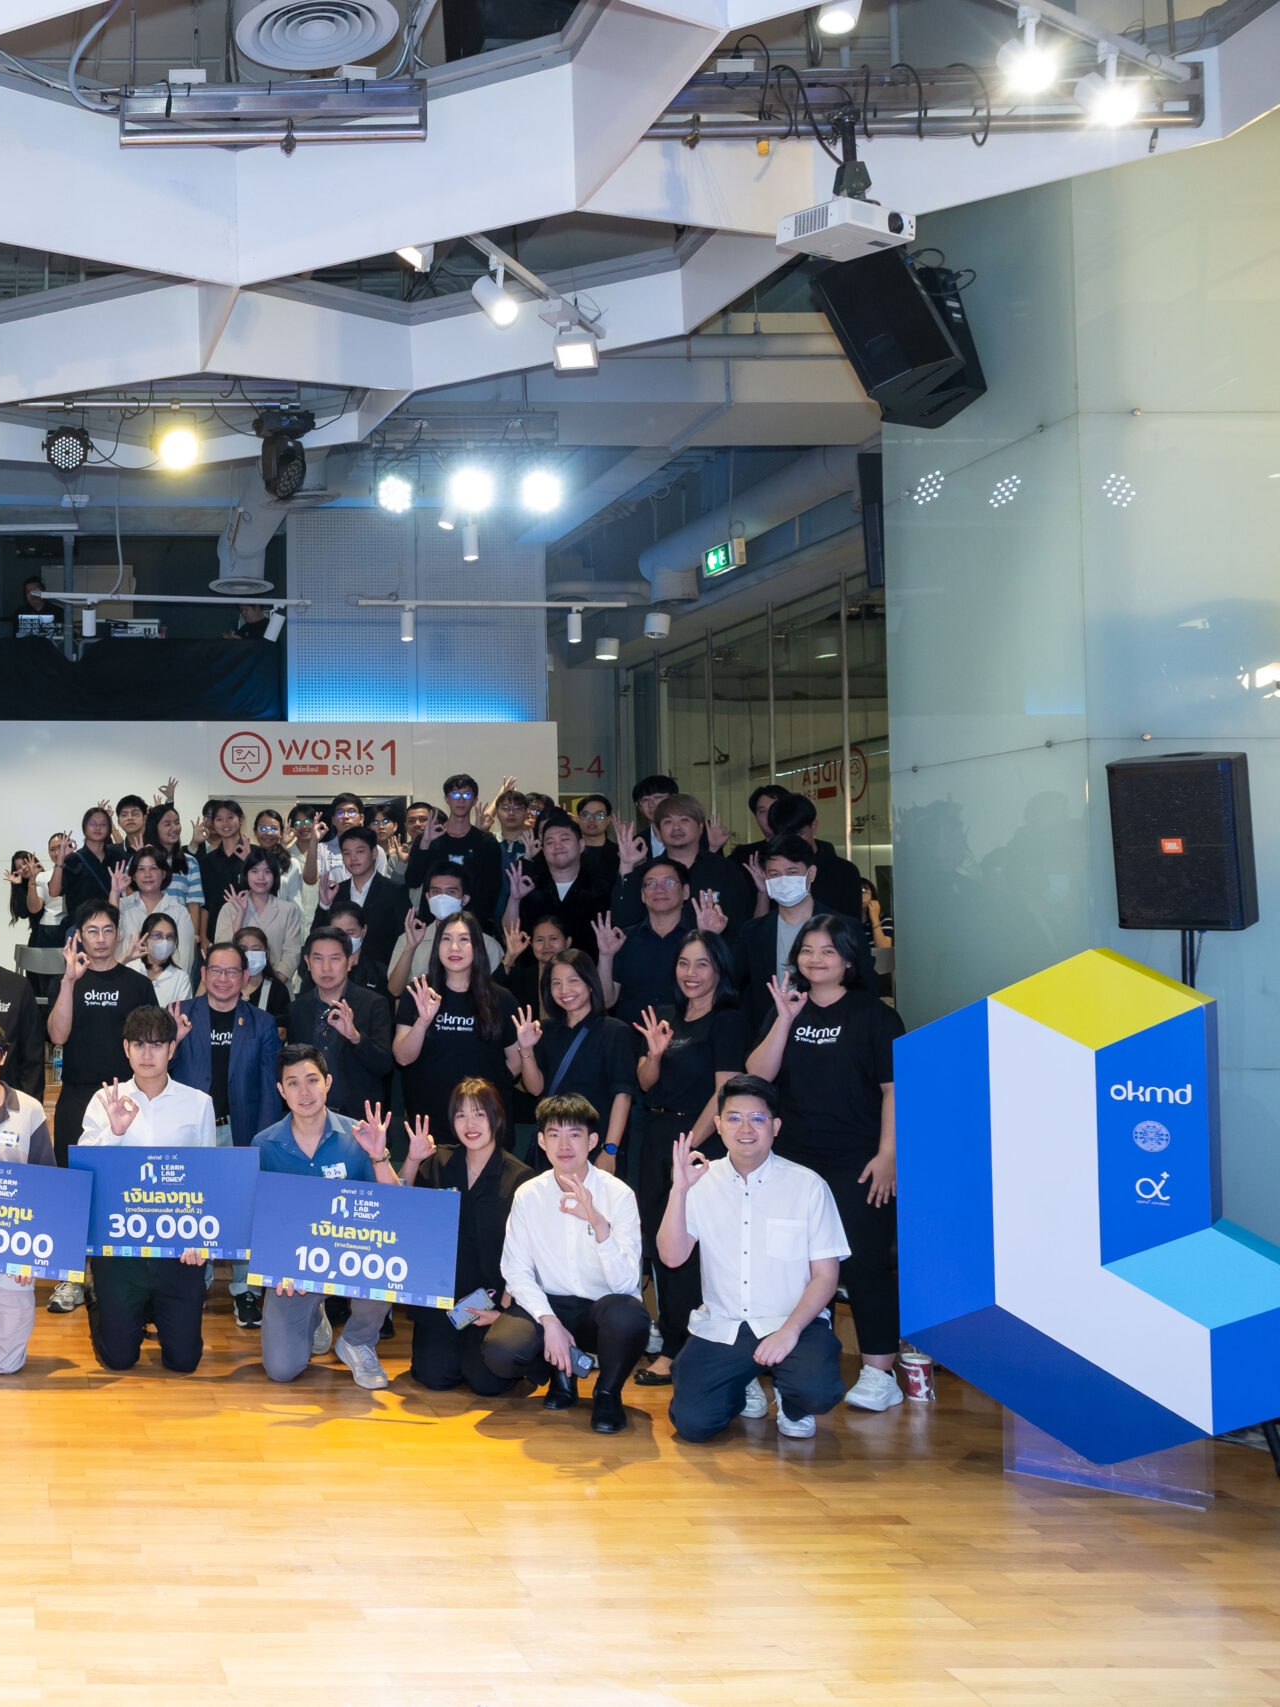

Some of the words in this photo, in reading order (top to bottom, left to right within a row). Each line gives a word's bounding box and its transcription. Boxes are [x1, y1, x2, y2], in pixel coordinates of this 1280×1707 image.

[278, 738, 374, 761] WORK
[380, 739, 396, 776] 1
[332, 764, 375, 776] SHOP
[558, 754, 606, 778] 3-4
[84, 989, 119, 1001] okmd
[436, 1012, 475, 1027] okmd
[210, 1029, 233, 1041] km
[796, 1025, 842, 1038] okmd
[1110, 1080, 1192, 1105] okmd
[124, 1188, 203, 1209] เงินลงทุน
[353, 1205, 369, 1213] LAB
[108, 1213, 220, 1243] 30,000
[311, 1220, 396, 1248] เงินลงทุน
[34, 1258, 49, 1267] บาท
[295, 1245, 408, 1283] 10,000
[387, 1282, 404, 1291] บาท
